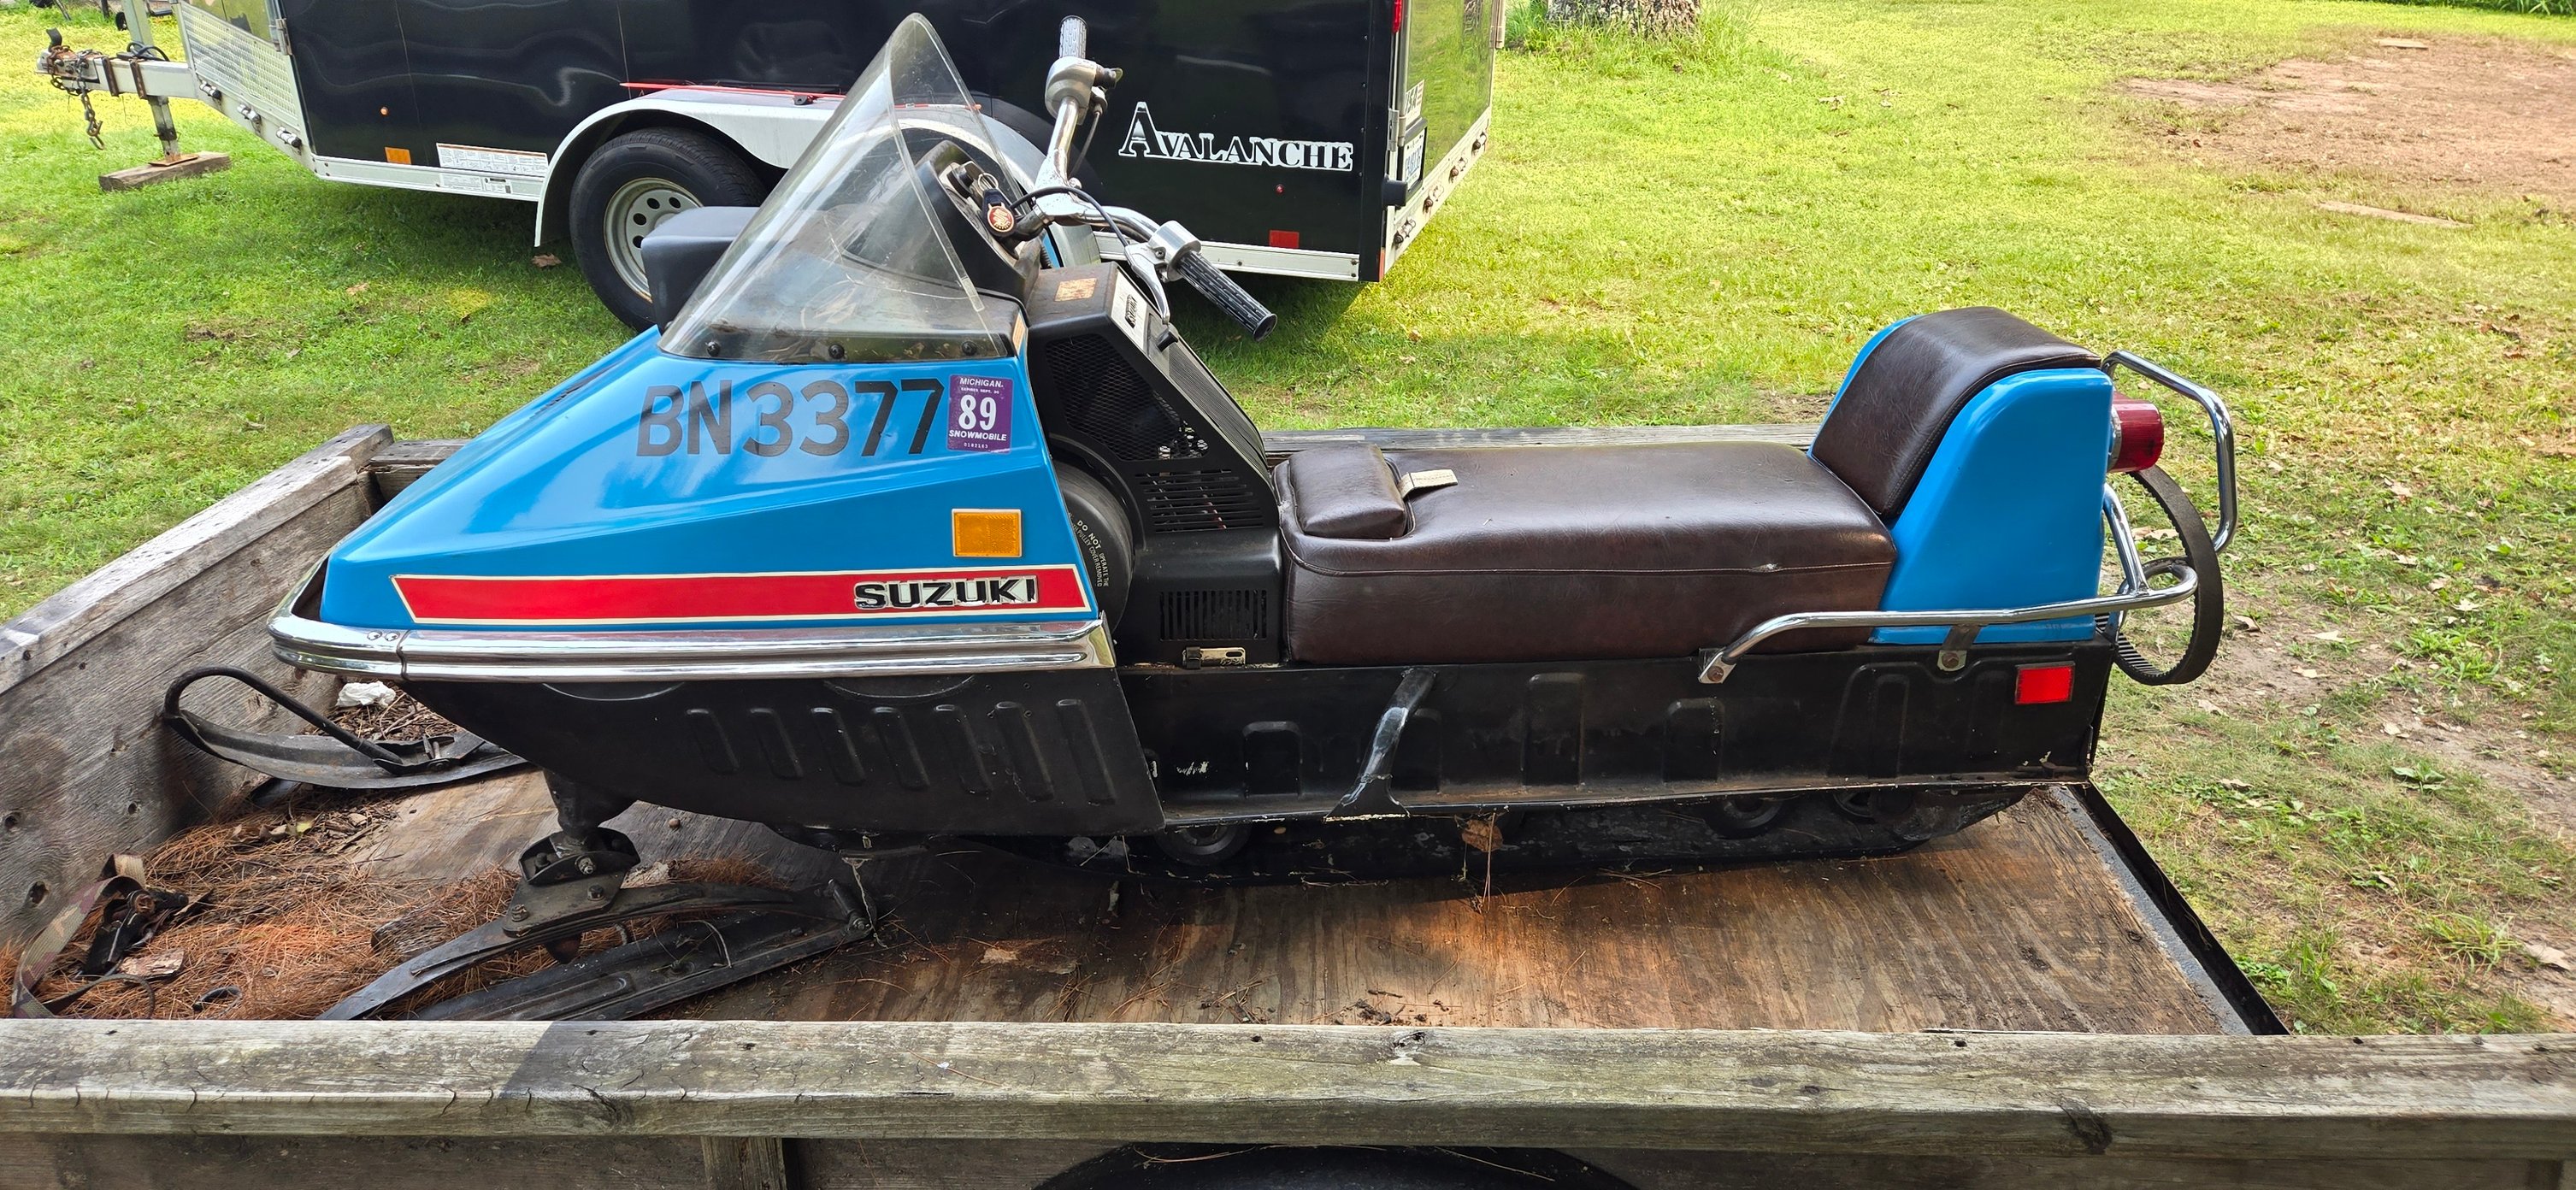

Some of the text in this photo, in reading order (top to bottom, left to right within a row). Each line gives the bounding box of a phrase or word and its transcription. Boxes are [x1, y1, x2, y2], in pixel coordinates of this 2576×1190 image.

[959, 394, 996, 430] 89
[948, 430, 1007, 441] SNOWMOBILE
[1077, 529, 1092, 546] PULLEY
[1088, 546, 1099, 563] COVER
[1077, 520, 1088, 531] DO
[1088, 533, 1101, 549] NOT
[1099, 552, 1109, 577] OPERATE
[855, 575, 1038, 610] SUZUKI
